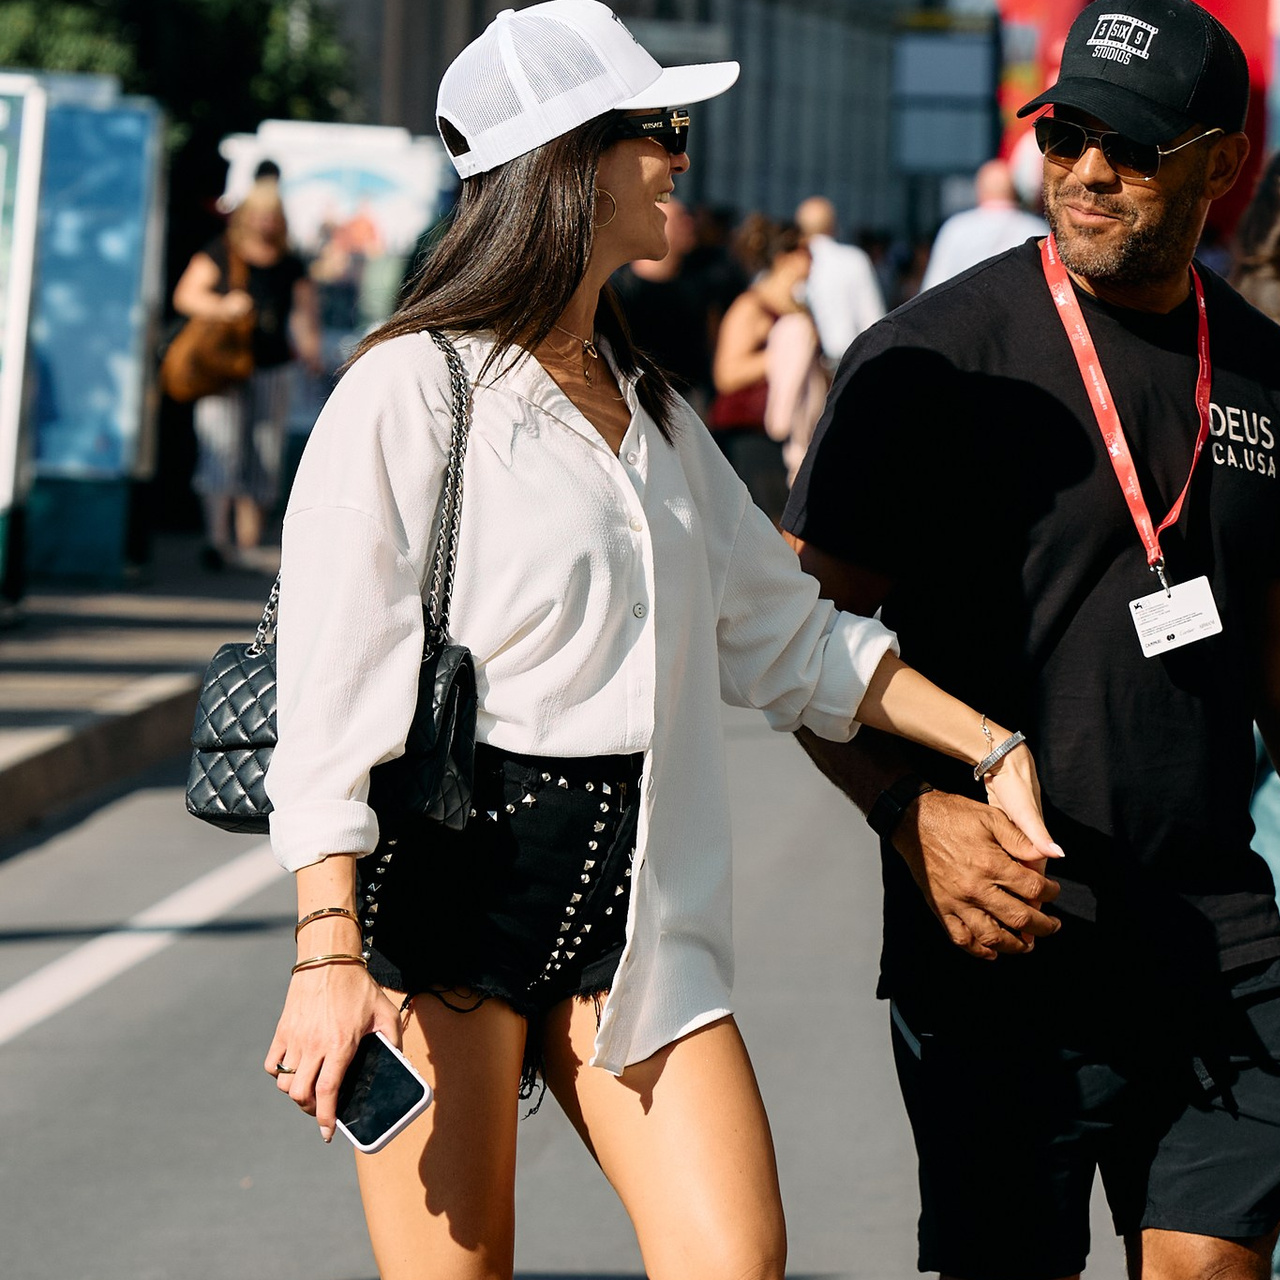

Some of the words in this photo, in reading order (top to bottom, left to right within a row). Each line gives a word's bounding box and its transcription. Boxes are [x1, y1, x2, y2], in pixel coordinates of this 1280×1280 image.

[1098, 22, 1108, 36] 3
[1111, 23, 1130, 39] SIX
[1134, 31, 1144, 45] 9
[1091, 45, 1133, 65] STUDIOS
[1209, 402, 1275, 450] DEUS
[1212, 442, 1276, 479] CA.USA
